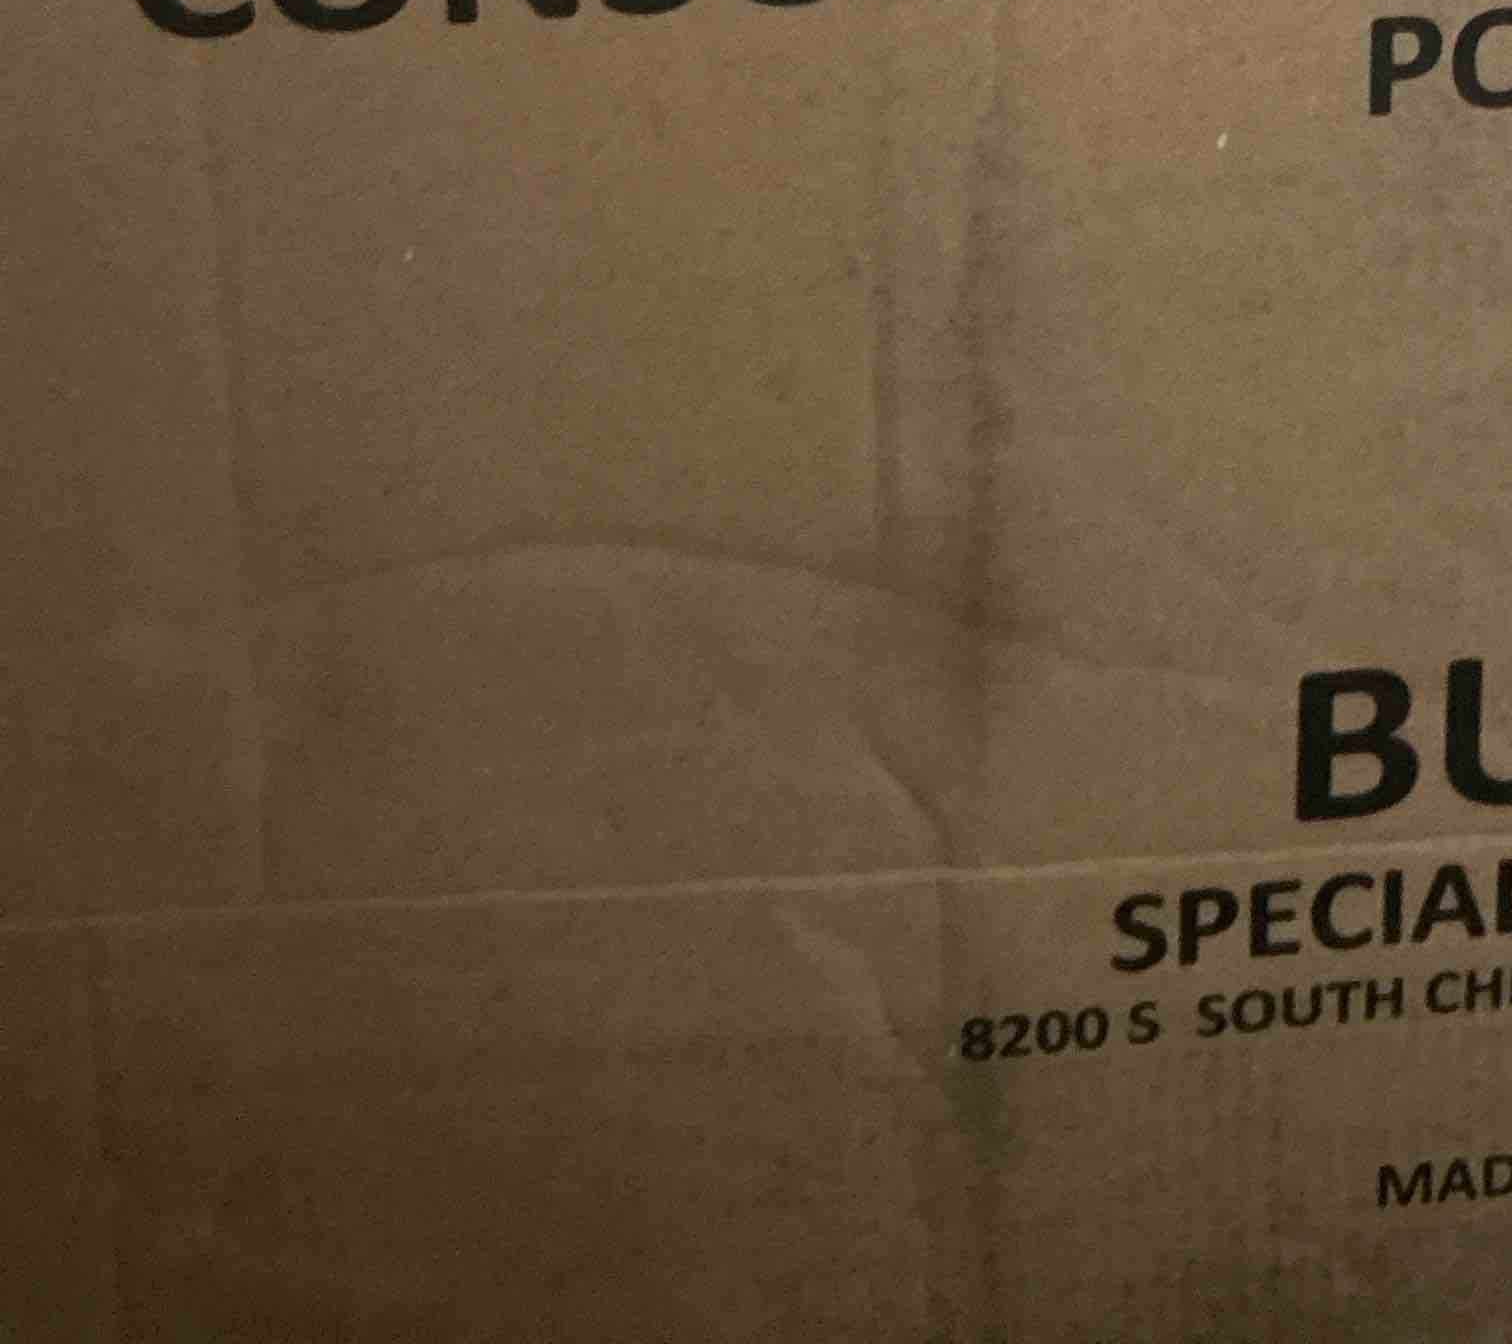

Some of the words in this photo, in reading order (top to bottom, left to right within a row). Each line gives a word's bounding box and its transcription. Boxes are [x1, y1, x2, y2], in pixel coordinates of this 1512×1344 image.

[960, 1007, 1109, 1062] 8200
[1127, 1001, 1161, 1045] S
[1196, 976, 1404, 1037] SOUTH
